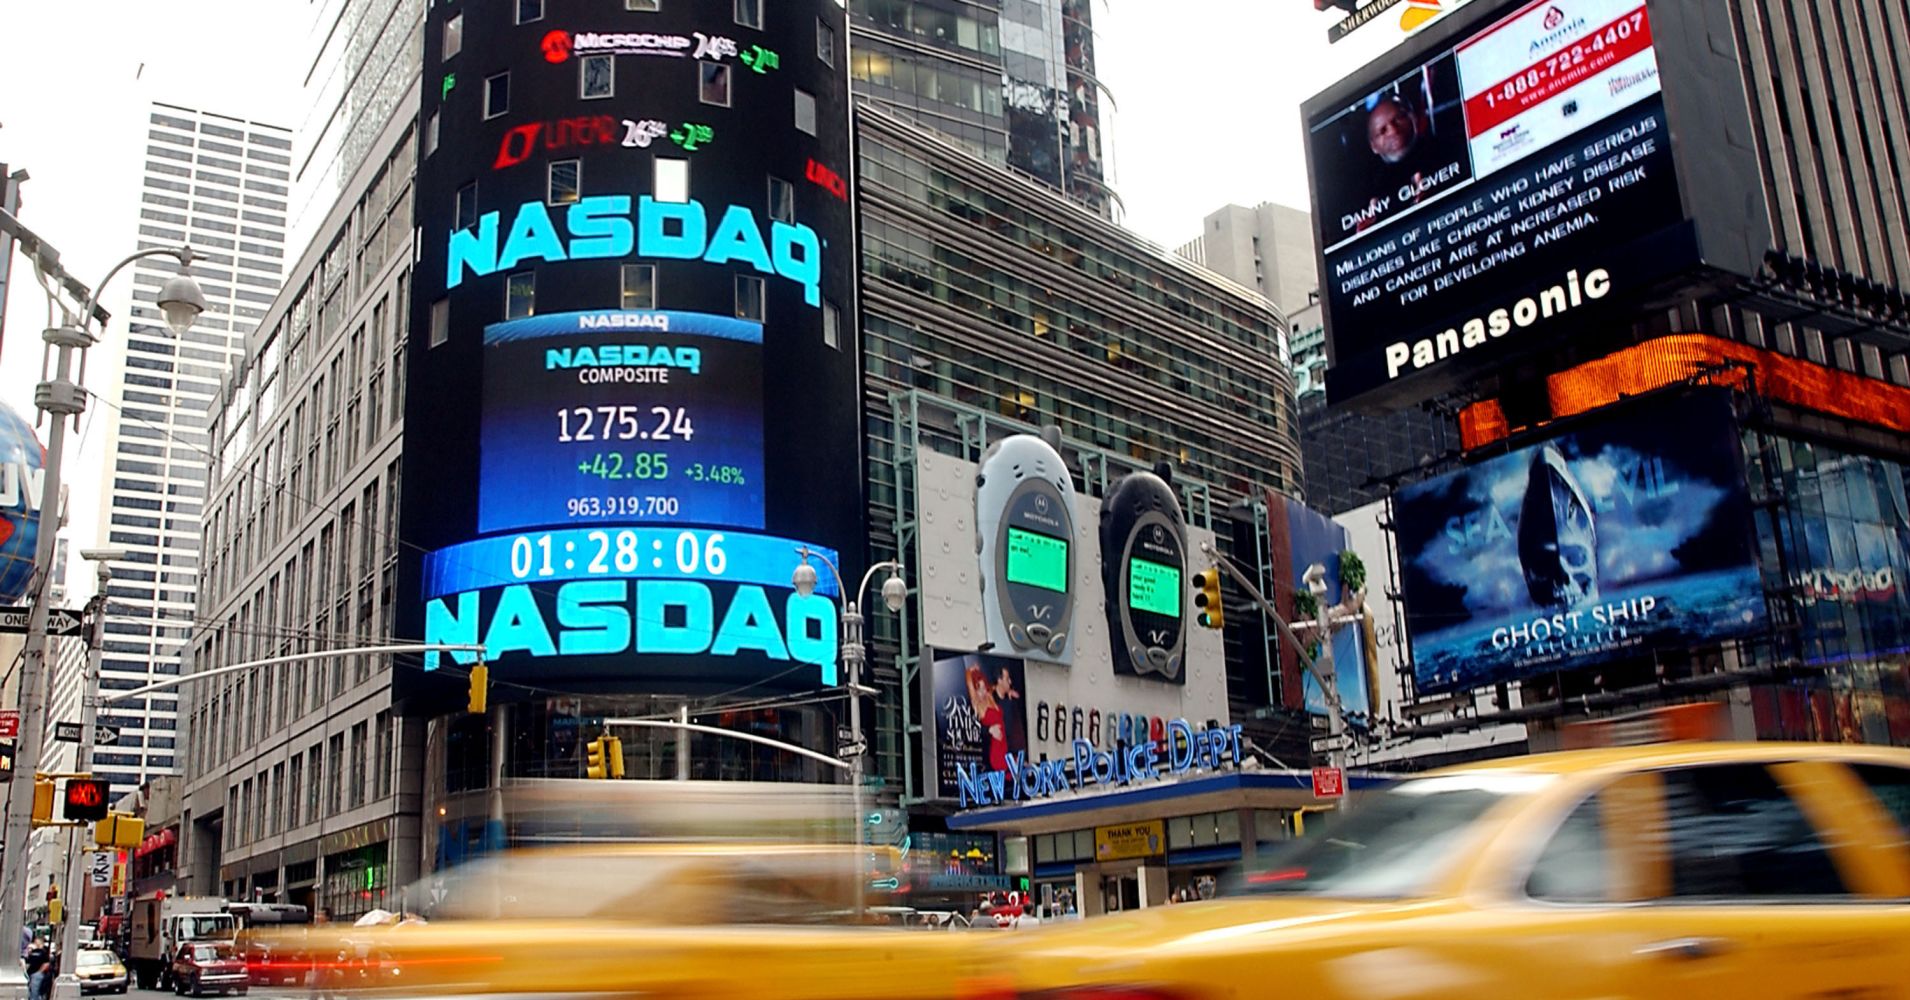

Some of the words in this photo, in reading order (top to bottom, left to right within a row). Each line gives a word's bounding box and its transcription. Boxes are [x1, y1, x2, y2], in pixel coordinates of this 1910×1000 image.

[1486, 12, 1643, 108] 1-888-722-4407
[1335, 239, 1397, 278] MILLIONS
[1402, 227, 1421, 246] OF
[1428, 198, 1484, 234] PEOPLE
[1490, 177, 1529, 204] WHO
[1535, 153, 1577, 183] HAVE
[1583, 116, 1657, 161] SERIOUS
[1341, 196, 1390, 231] DANNY
[1398, 161, 1460, 202] GLOVER
[1341, 255, 1405, 294] DISEASES
[1410, 238, 1441, 262] LIKE
[1447, 205, 1512, 245] CHRONIC
[1518, 176, 1574, 212] KIDNEY
[1583, 138, 1656, 183] DISEASE
[447, 195, 822, 309] NASDAQ
[1353, 287, 1381, 307] AND
[1385, 258, 1442, 292] CANCER
[1449, 242, 1479, 264] ARE
[1486, 229, 1504, 248] AT
[1510, 186, 1602, 237] INCREASED
[1608, 165, 1647, 193] RISK
[1400, 284, 1429, 306] FOR
[1433, 241, 1526, 291] DEVELOPING
[580, 314, 668, 331] NASDAQ
[1385, 268, 1612, 380] Panasonic
[546, 345, 701, 375] NASDAQ
[578, 368, 669, 384] COMPOSITE
[557, 406, 694, 443] 1275.24
[578, 453, 669, 480] +42.85
[684, 464, 745, 485] +3.48%
[567, 497, 679, 518] 963,919,700
[1445, 505, 1512, 554] SEA
[5, 614, 29, 626] ONE
[424, 580, 838, 687] NASDAQ
[1492, 610, 1583, 652] GHOST
[1592, 595, 1656, 625] SHIP
[956, 761, 1006, 808] NEW
[1005, 750, 1070, 801] YORK
[1072, 738, 1160, 788] POLICE
[1168, 718, 1243, 774] DEPT
[1107, 826, 1132, 839] THANK
[1135, 826, 1151, 836] YOU
